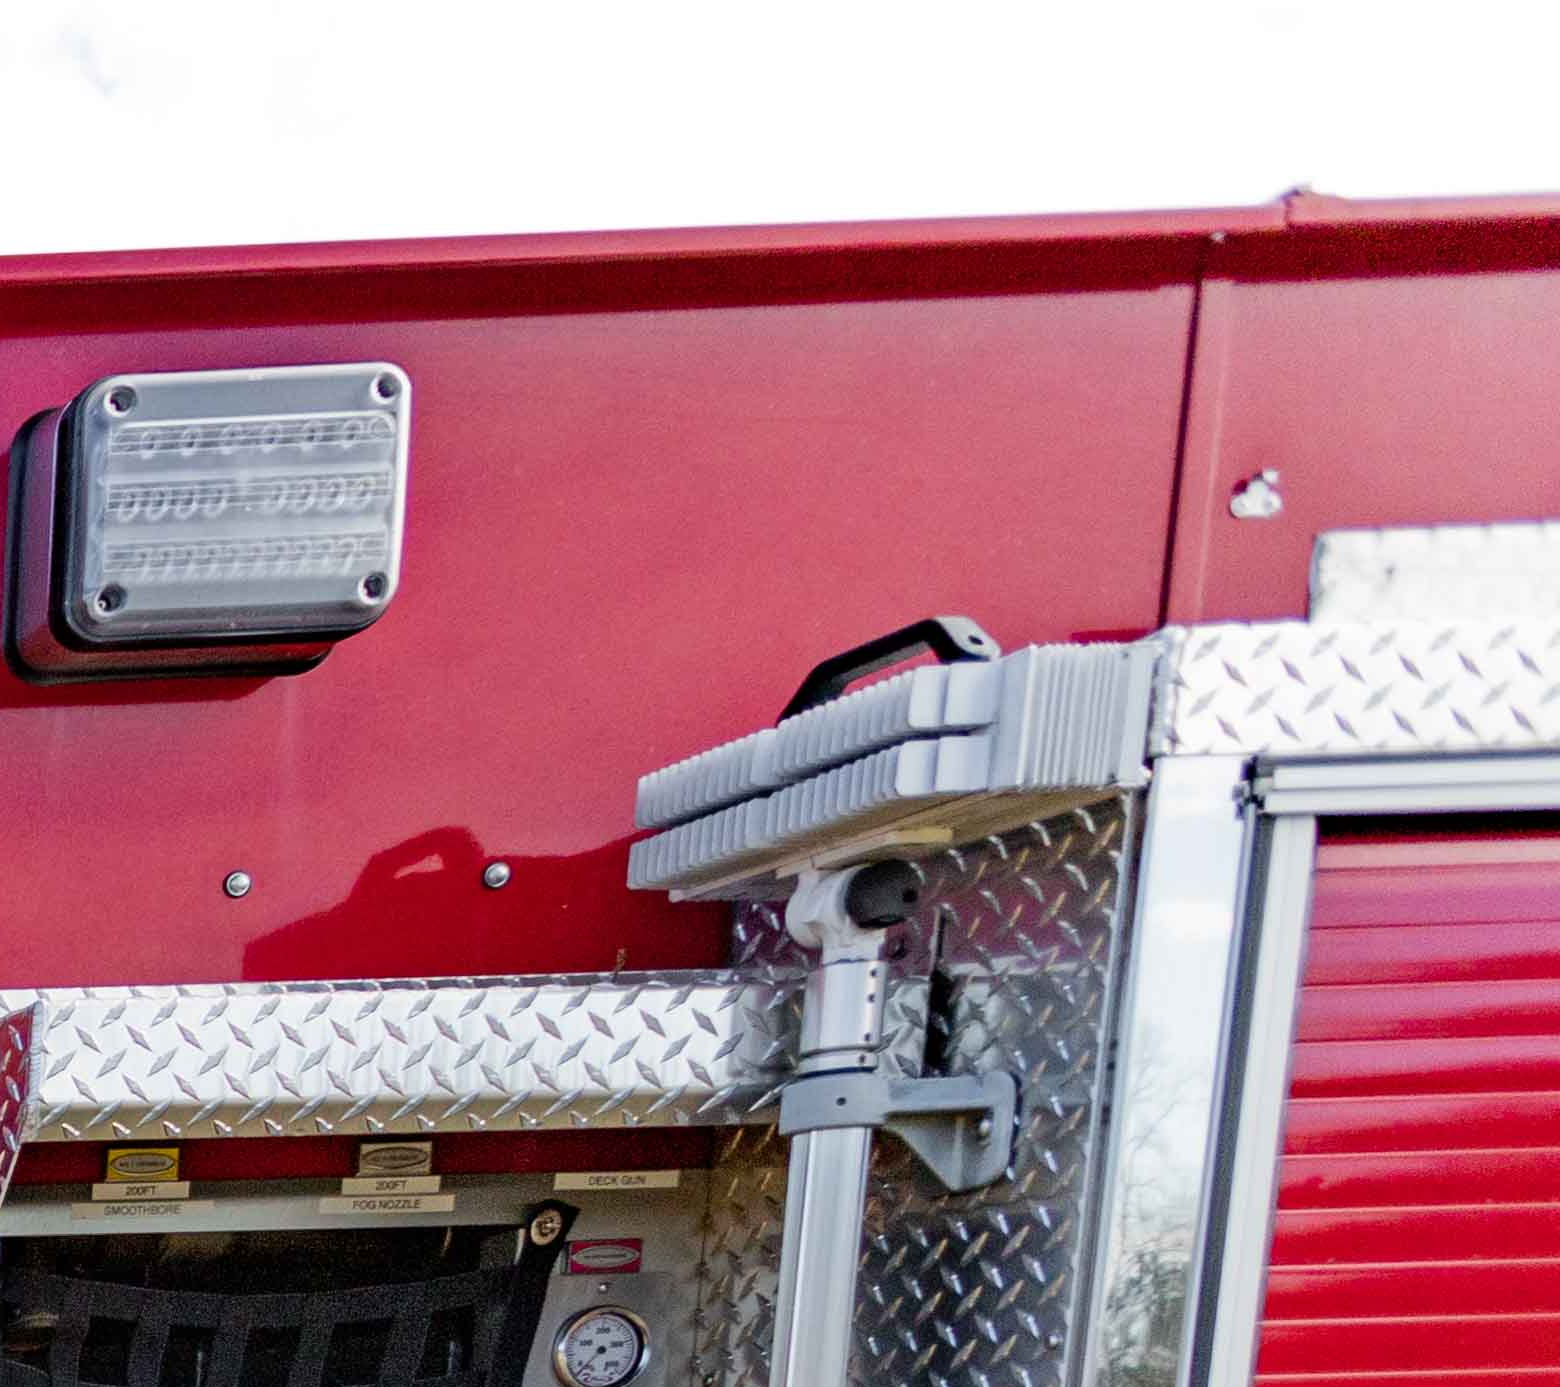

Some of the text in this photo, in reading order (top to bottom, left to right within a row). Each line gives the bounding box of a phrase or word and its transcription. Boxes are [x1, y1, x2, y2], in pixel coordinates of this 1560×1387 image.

[587, 1175, 617, 1186] DECK
[103, 1204, 182, 1216] SMOOTHBORE
[352, 1199, 422, 1210] FOG NOZZLE
